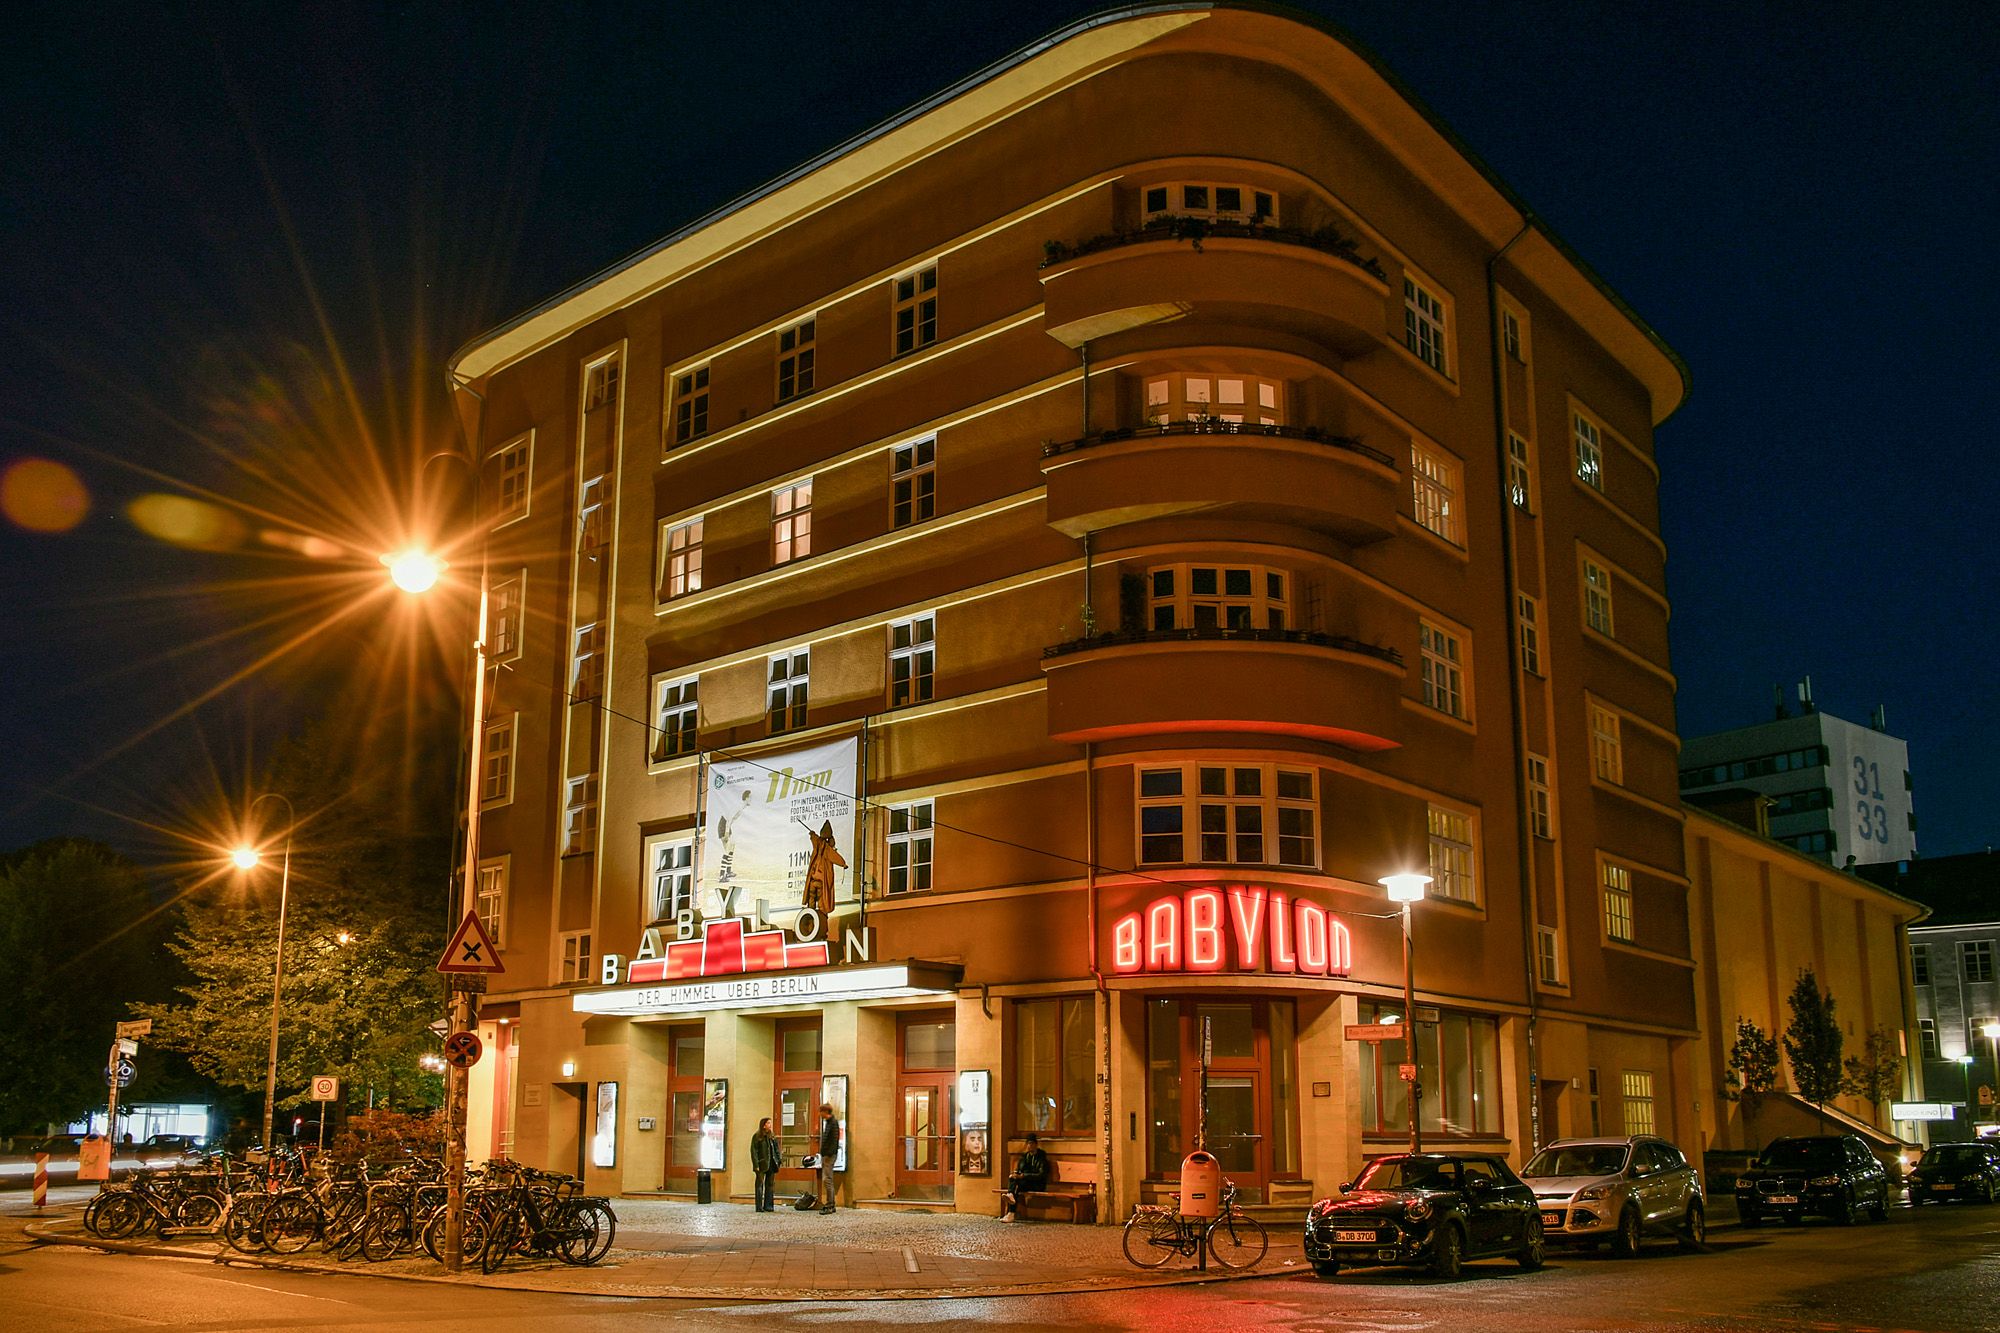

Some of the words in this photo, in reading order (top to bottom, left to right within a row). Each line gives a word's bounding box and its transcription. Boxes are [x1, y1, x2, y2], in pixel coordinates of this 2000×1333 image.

[1853, 755, 1884, 801] 31
[790, 805, 814, 815] FOOTBALL
[814, 803, 826, 812] FILM
[826, 799, 850, 810] FESTIVAL
[801, 793, 839, 806] INTERNATIONAL
[790, 814, 807, 824] BERLIN
[1857, 800, 1889, 845] 33
[602, 886, 872, 985] BABYLON
[1112, 885, 1351, 976] BABYLON
[638, 990, 661, 1005] DER
[671, 985, 717, 1002] HIMMEL
[771, 976, 819, 994] BERLIN
[321, 1083, 329, 1091] 30
[1919, 1109, 1939, 1117] KINO
[1346, 1232, 1355, 1240] DB
[1357, 1232, 1374, 1240] 3700
